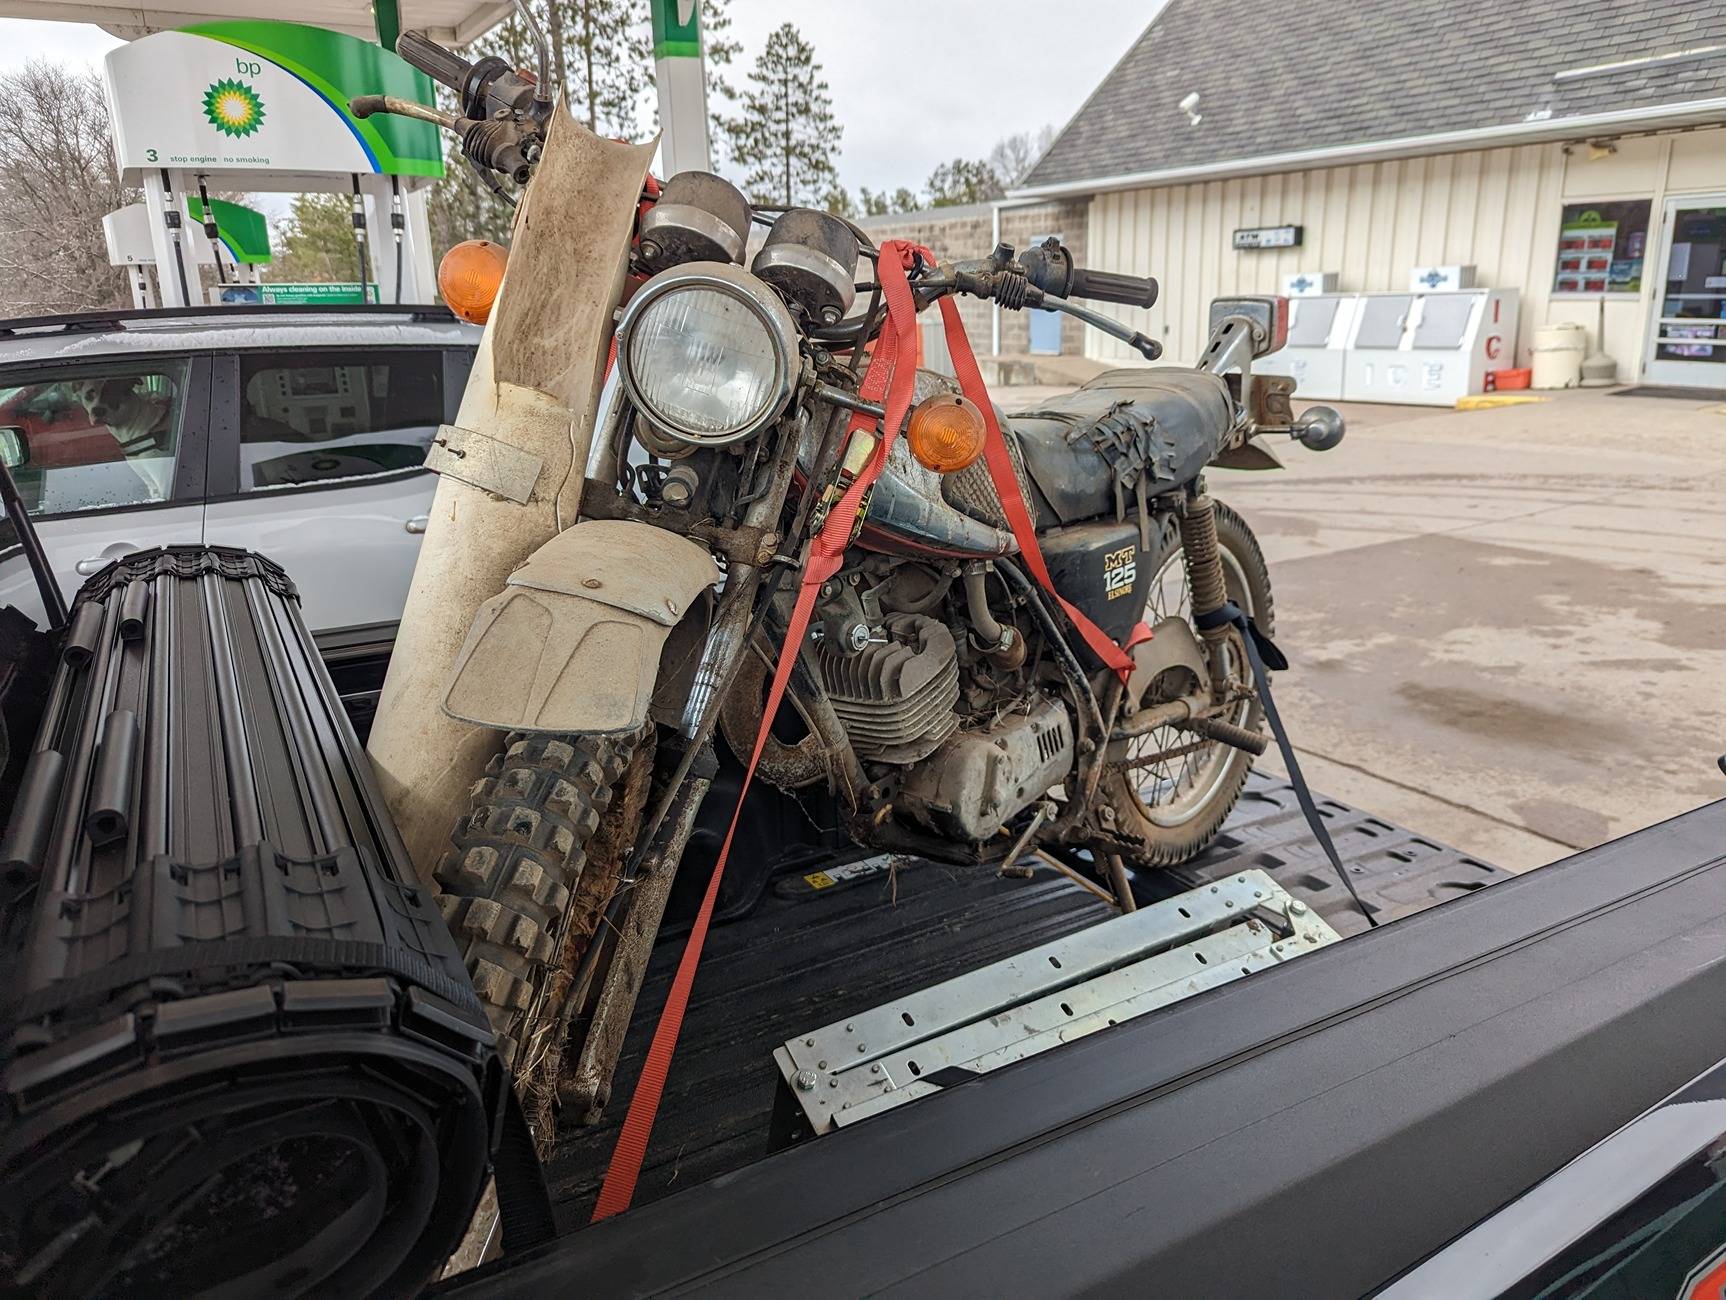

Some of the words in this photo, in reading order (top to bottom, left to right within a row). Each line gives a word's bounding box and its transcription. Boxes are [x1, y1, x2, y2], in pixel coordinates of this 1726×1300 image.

[236, 57, 261, 78] bp
[146, 149, 158, 162] 3
[170, 155, 188, 163] stop
[190, 156, 217, 164] engine
[236, 156, 270, 165] smoking
[262, 286, 288, 294] Always
[289, 286, 317, 294] cleaning
[1104, 562, 1136, 592] 125
